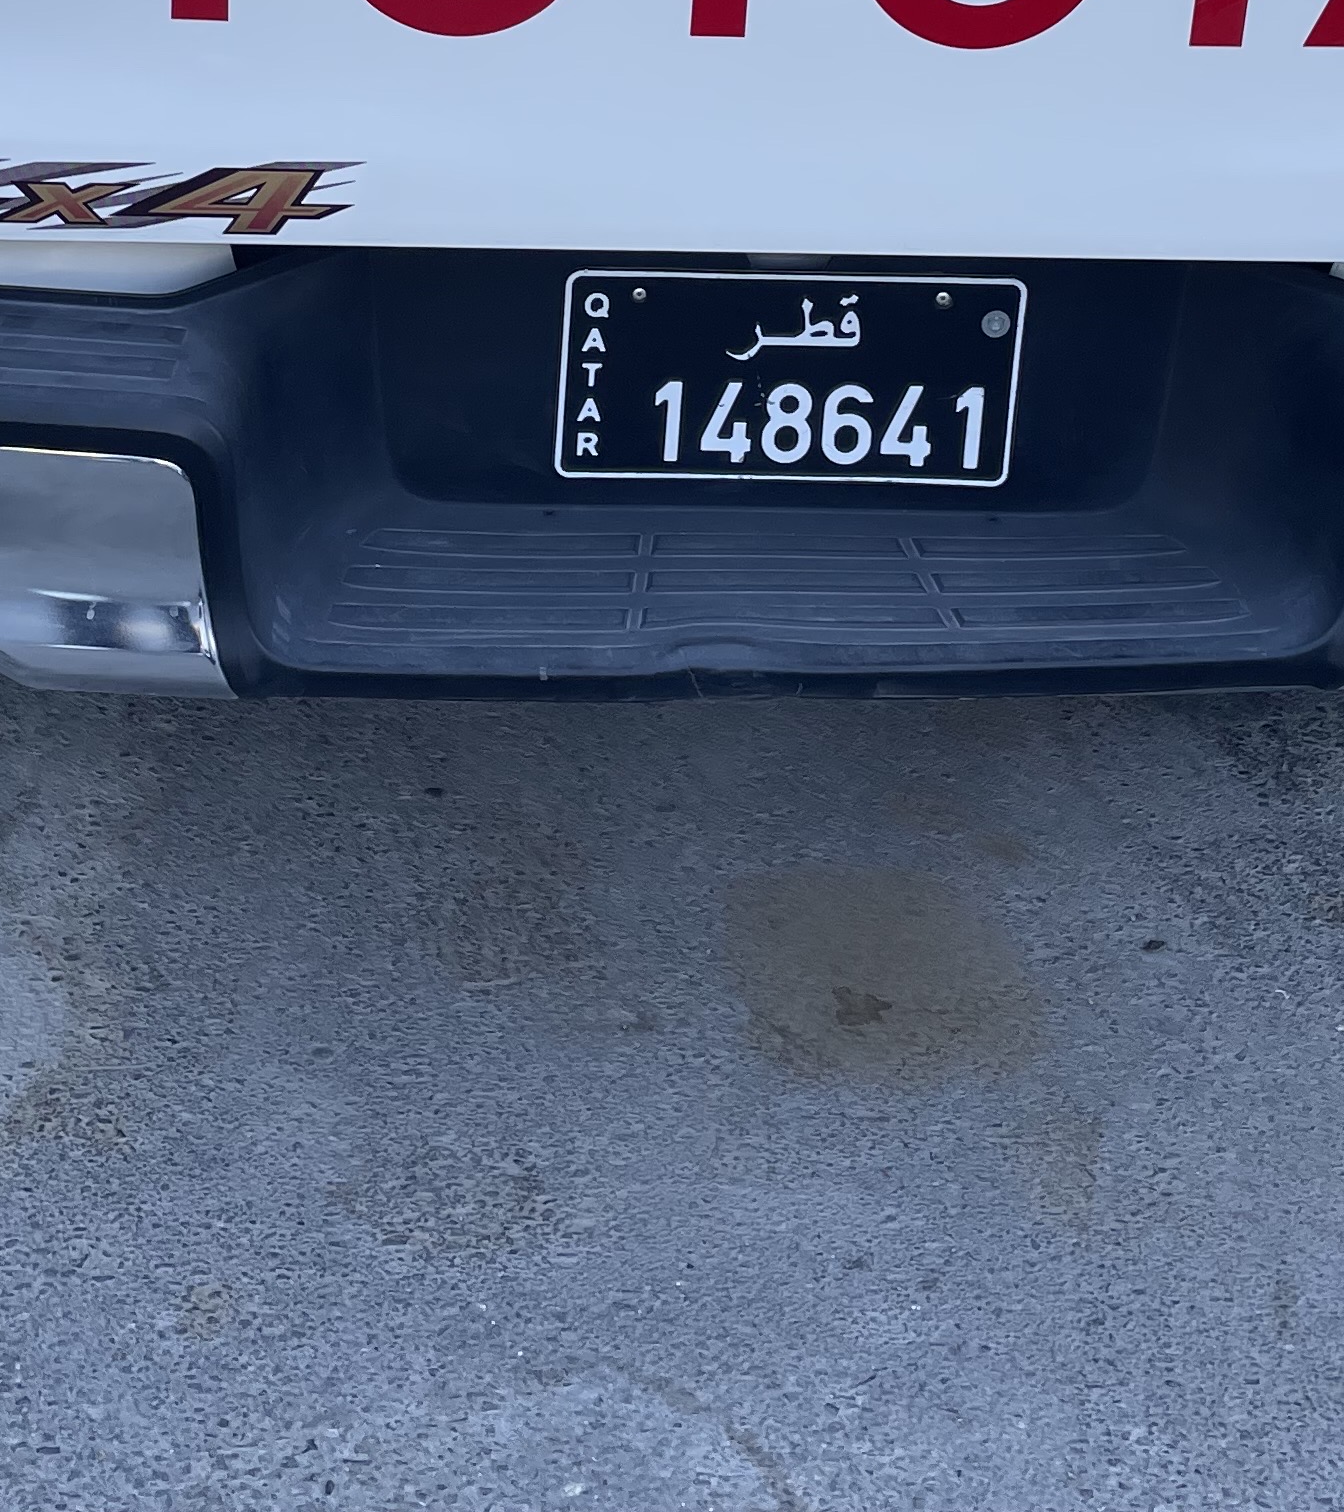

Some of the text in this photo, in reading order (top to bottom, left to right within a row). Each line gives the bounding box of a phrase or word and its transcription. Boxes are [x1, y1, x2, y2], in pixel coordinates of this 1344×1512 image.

[725, 294, 861, 361] قطر
[576, 292, 610, 457] QATAR
[654, 381, 986, 470] 148641
